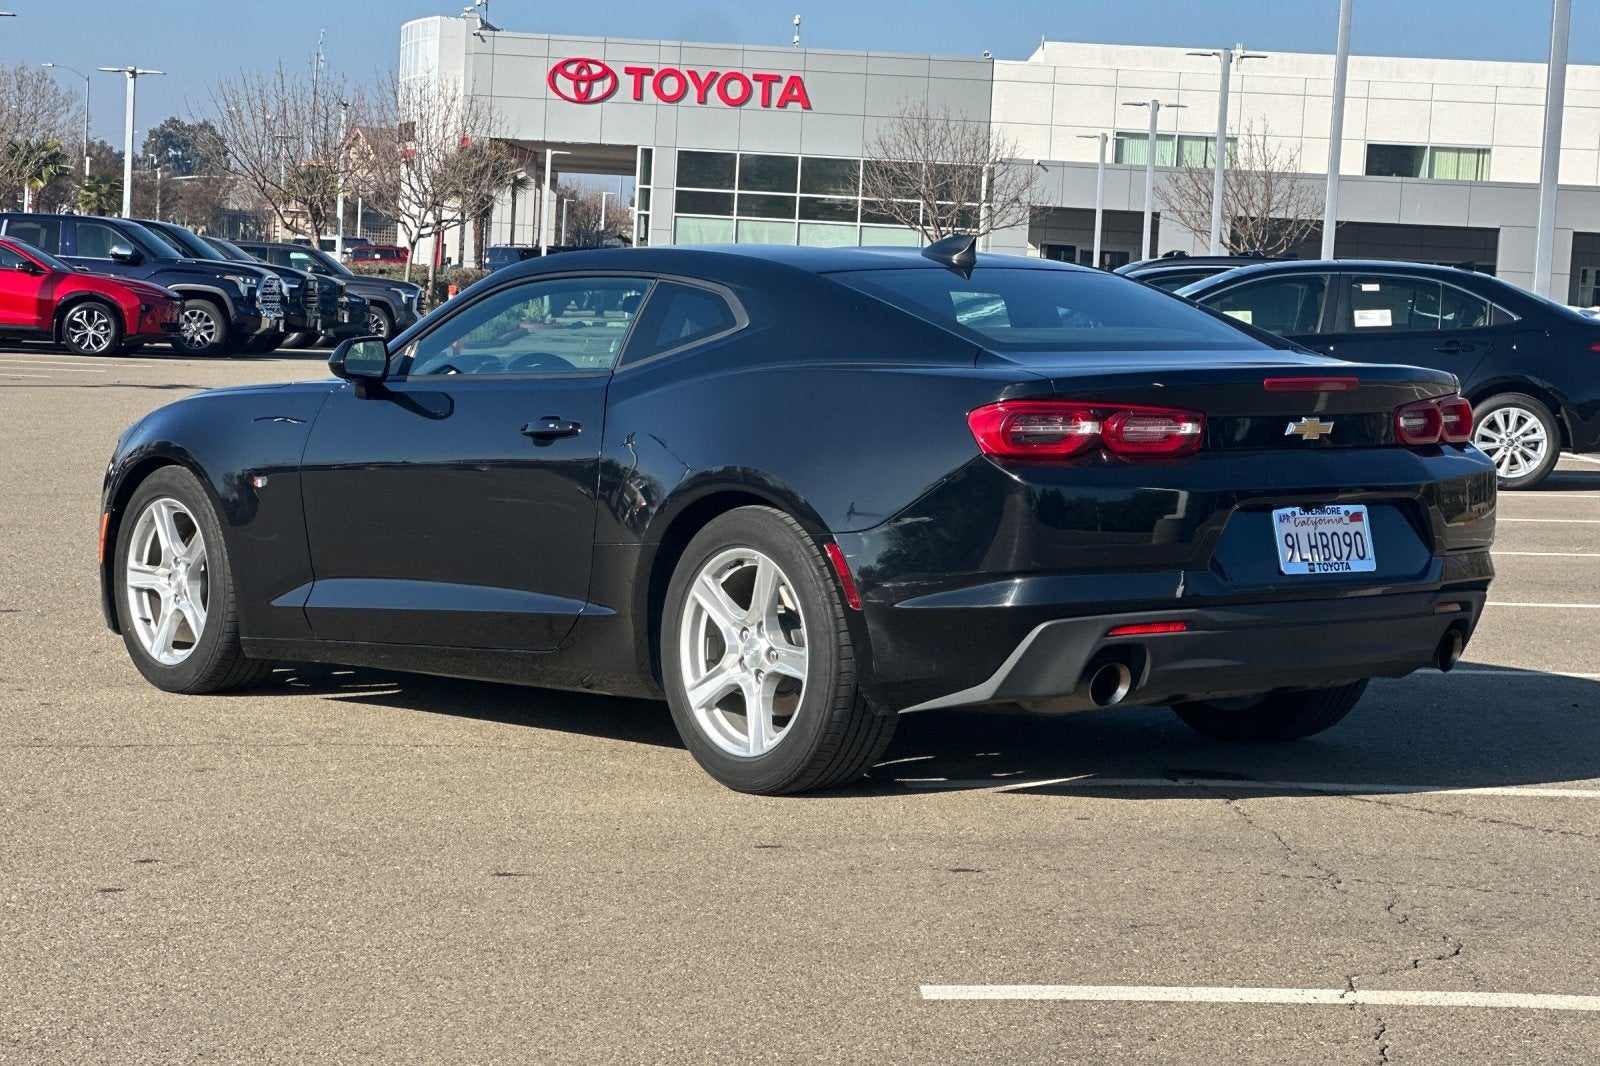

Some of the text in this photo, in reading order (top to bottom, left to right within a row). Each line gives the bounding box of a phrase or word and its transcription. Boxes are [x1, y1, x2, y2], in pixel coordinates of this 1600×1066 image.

[624, 66, 812, 110] TOYOTA
[1294, 517, 1349, 531] California
[1284, 531, 1366, 563] 9LHB090
[1317, 562, 1352, 572] TOYOTA
